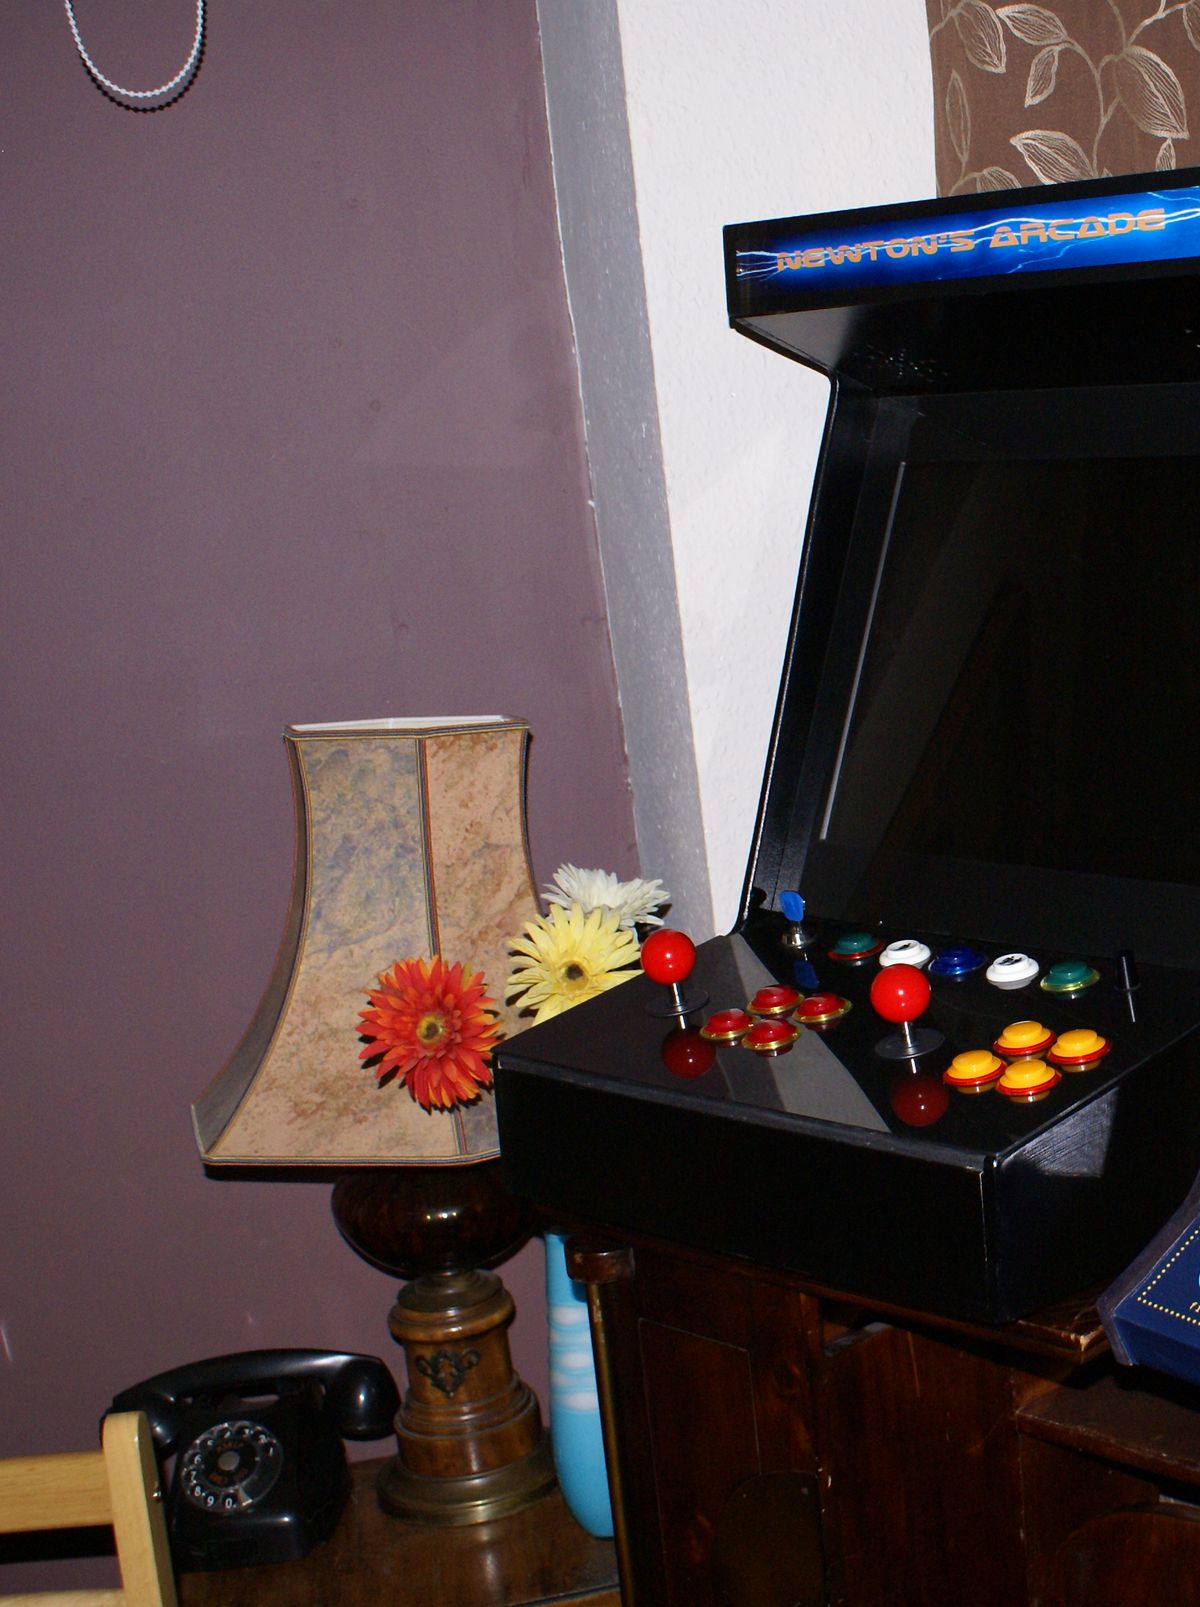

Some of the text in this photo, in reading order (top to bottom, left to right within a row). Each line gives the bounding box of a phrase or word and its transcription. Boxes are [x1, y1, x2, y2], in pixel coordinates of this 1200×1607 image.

[776, 207, 1166, 272] NEWTON'S ARCADE
[193, 1454, 203, 1465] 6
[193, 1485, 203, 1497] 8
[206, 1495, 215, 1507] 9
[224, 1497, 234, 1510] 0
